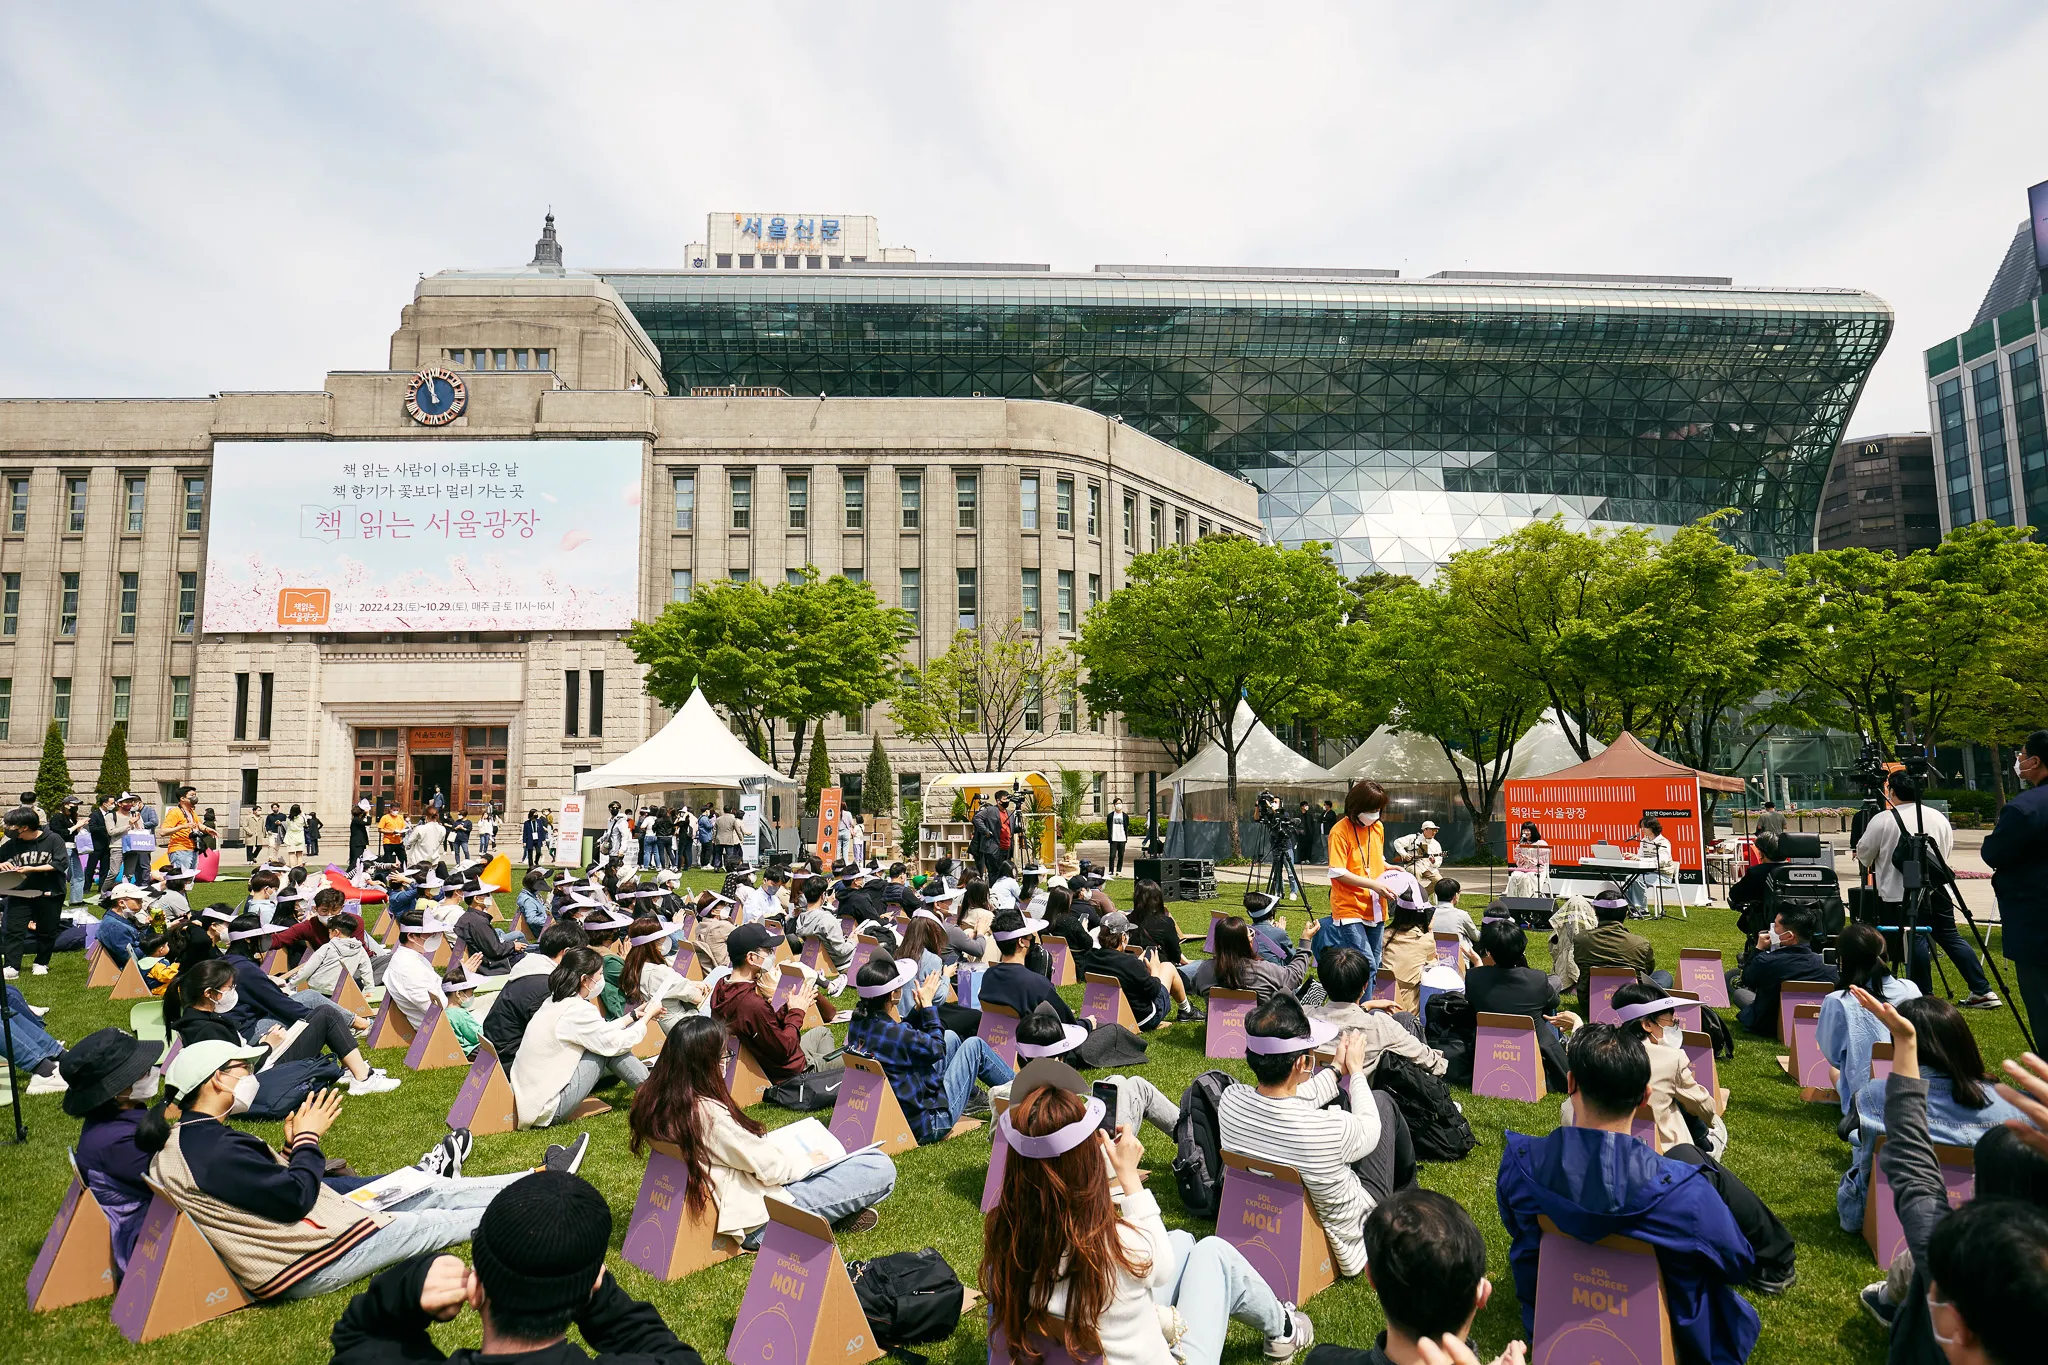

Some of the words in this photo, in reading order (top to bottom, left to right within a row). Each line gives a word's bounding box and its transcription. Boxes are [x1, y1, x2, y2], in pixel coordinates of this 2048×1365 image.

[742, 217, 841, 240] 서울신문
[343, 463, 356, 478] 책
[362, 462, 390, 478] 읽는
[393, 462, 437, 478] 사람이
[441, 462, 501, 478] 아름다운
[505, 462, 519, 478] 날
[332, 484, 346, 499] 책
[351, 484, 395, 500] 향기가
[398, 484, 442, 499] 꽃보다
[446, 484, 473, 499] 멀리
[478, 484, 507, 499] 가는
[509, 484, 525, 499] 곳
[315, 509, 341, 540] 책
[360, 509, 415, 540] 읽는
[423, 508, 541, 539] 서울광장
[294, 602, 316, 612] 책읽는
[334, 602, 352, 613] 일시
[471, 602, 489, 612] 매주
[515, 601, 555, 612] 11시~16시
[289, 612, 319, 623] 서울광장
[414, 731, 452, 739] 서울도서관
[1510, 806, 1542, 819] 책읽는
[1543, 807, 1587, 820] 서울광장
[1695, 973, 1715, 981] MOLI
[1092, 1001, 1110, 1010] MOLI
[988, 1034, 1008, 1046] MOLI
[1493, 1050, 1521, 1062] MOLI
[847, 1097, 869, 1113] MOLI
[649, 1189, 672, 1212] MOLI
[1258, 1194, 1271, 1203] SOL
[1245, 1198, 1283, 1215] EXPLORERS
[1242, 1209, 1282, 1235] MOLI
[789, 1252, 801, 1264] SOL
[777, 1258, 809, 1278] EXPLORERS
[1590, 1267, 1610, 1279] SOL
[769, 1271, 805, 1301] MOLI
[1573, 1272, 1629, 1293] EXPLORERS
[1572, 1287, 1629, 1318] MOLI
